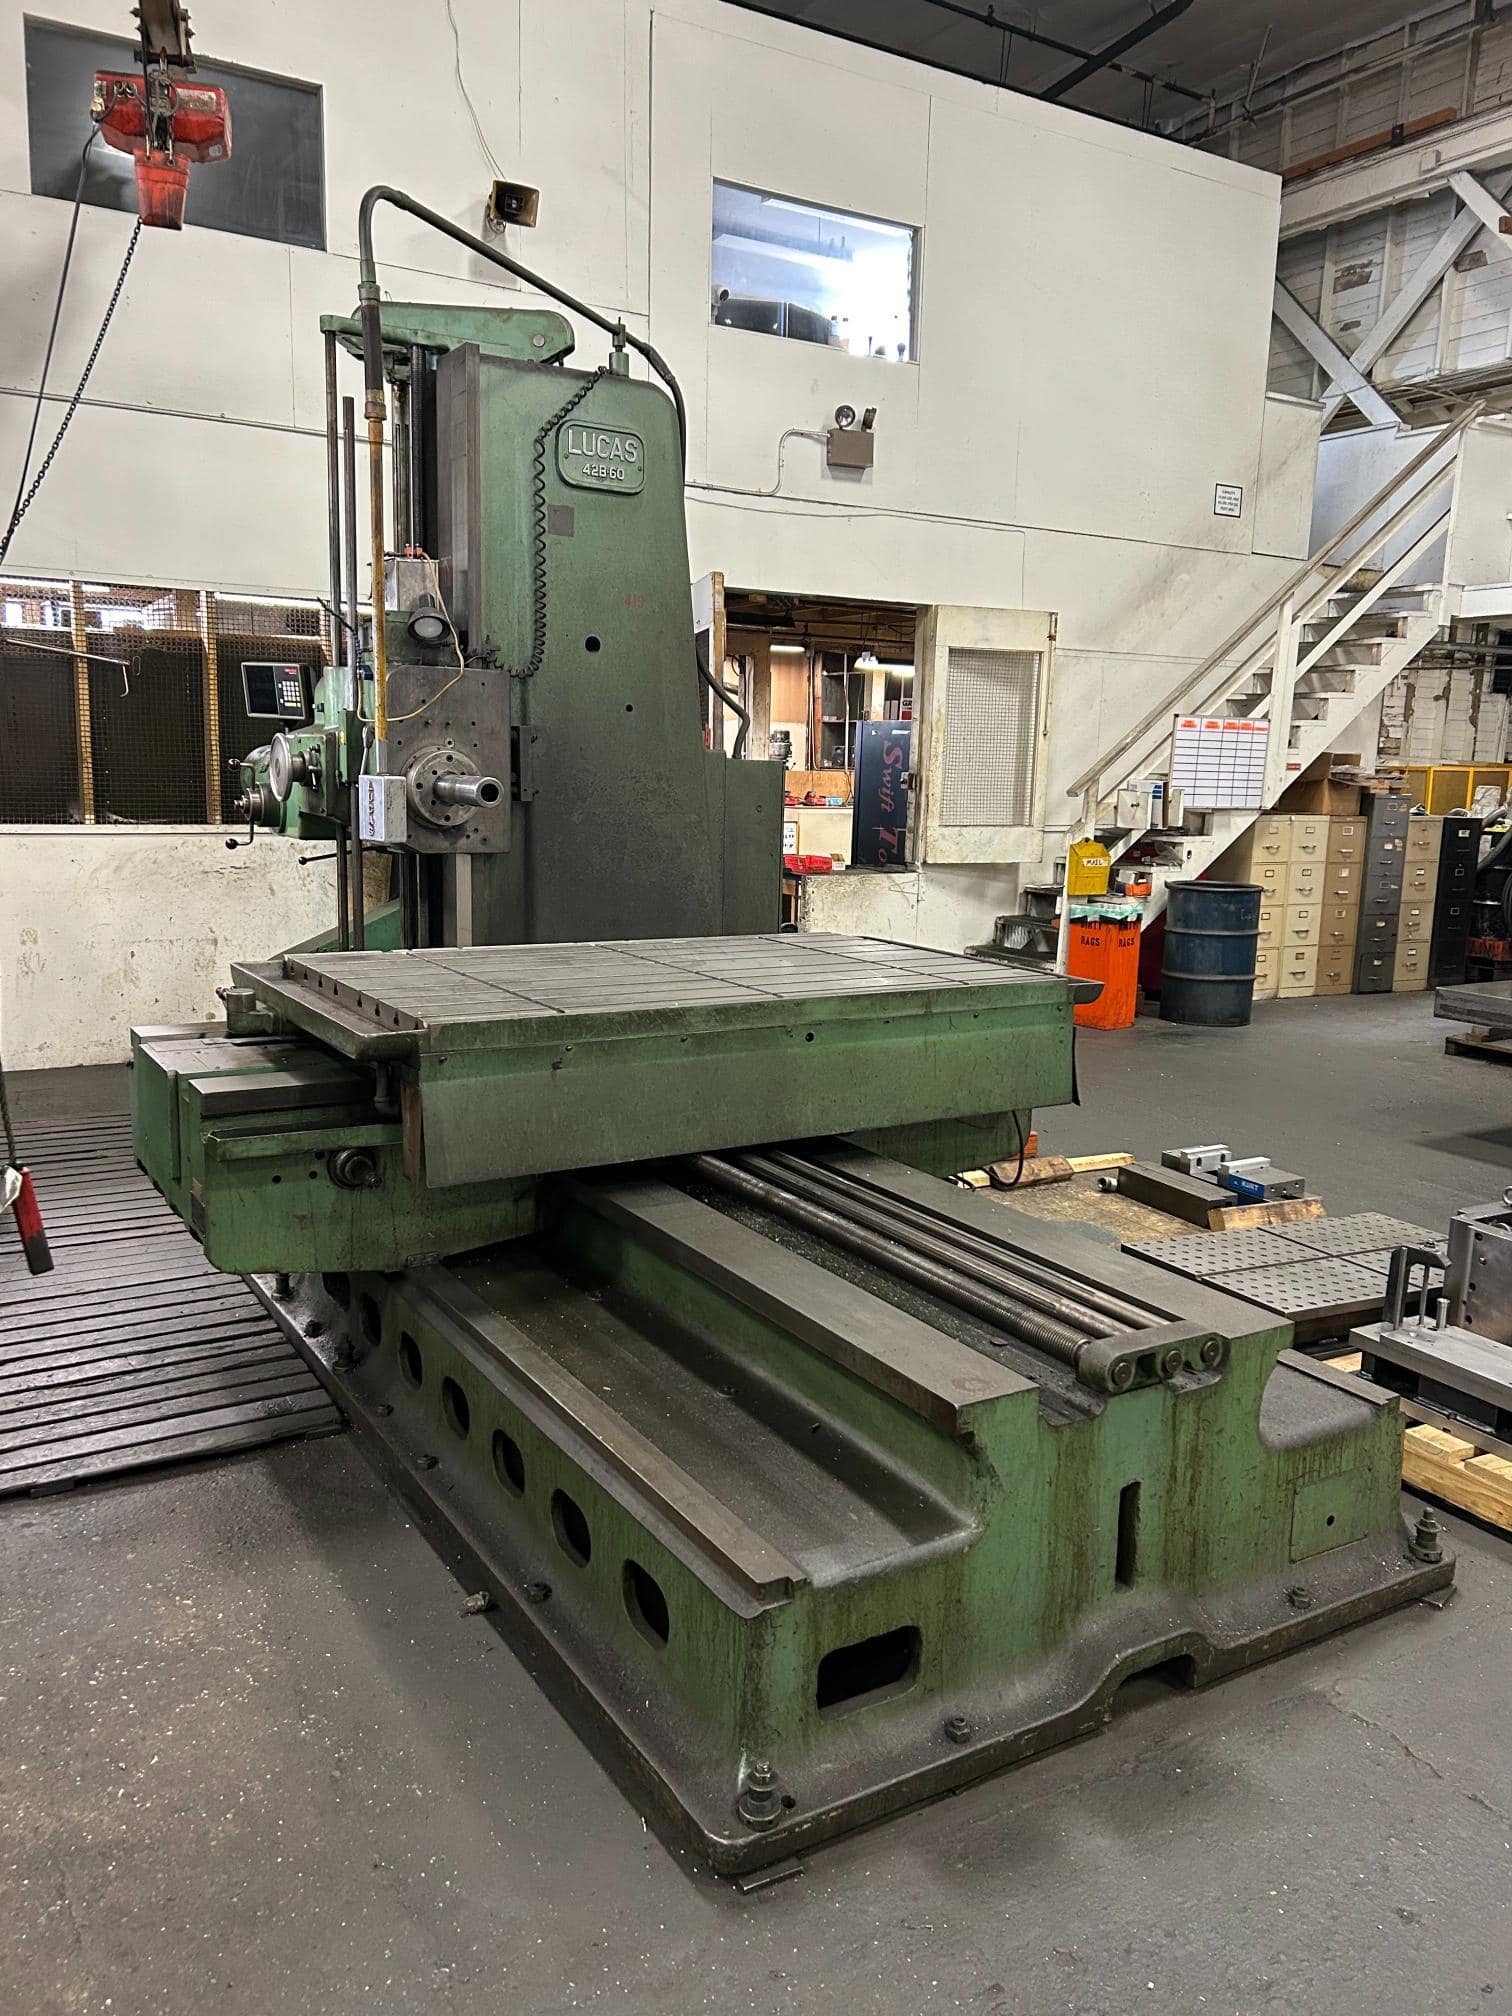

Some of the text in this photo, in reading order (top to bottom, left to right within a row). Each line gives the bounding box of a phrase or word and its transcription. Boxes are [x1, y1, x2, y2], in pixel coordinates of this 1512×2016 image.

[568, 429, 638, 463] LUCAS
[878, 740, 904, 814] Swift
[1086, 858, 1103, 866] MAIL
[1080, 935, 1101, 946] RAGS
[1119, 937, 1136, 948] RAGS
